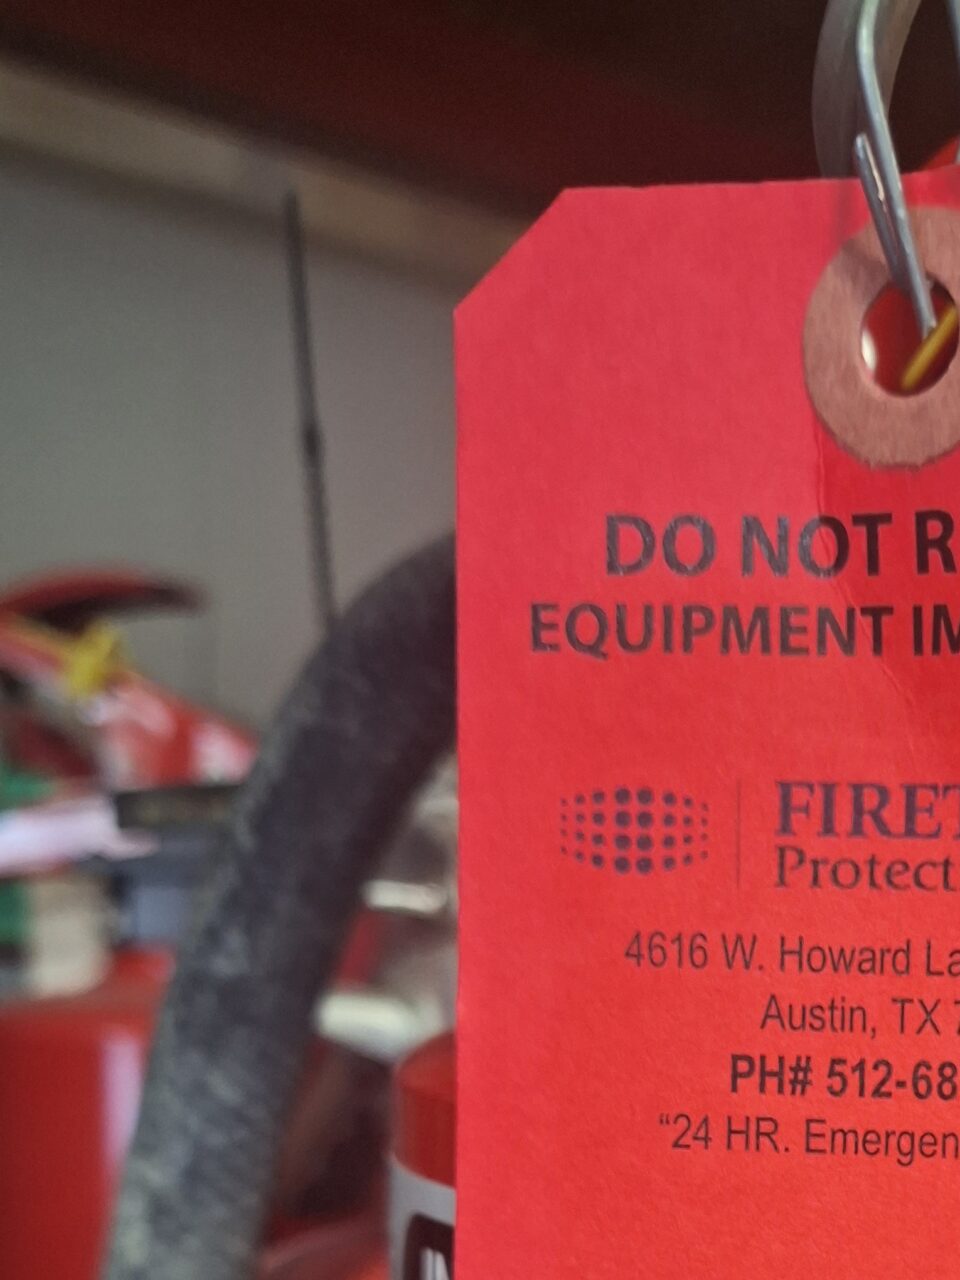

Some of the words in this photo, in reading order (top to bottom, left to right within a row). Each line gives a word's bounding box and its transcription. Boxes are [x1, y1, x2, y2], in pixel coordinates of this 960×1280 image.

[605, 512, 716, 578] DO
[742, 511, 893, 579] NOT
[530, 602, 893, 661] EQUIPMENT
[624, 931, 708, 971] 4616
[721, 936, 765, 972] W.
[779, 936, 911, 978] Howard
[761, 994, 877, 1040] Austin,
[891, 998, 941, 1036] TX
[730, 1055, 813, 1098] PH#
[726, 1116, 789, 1155] HR.
